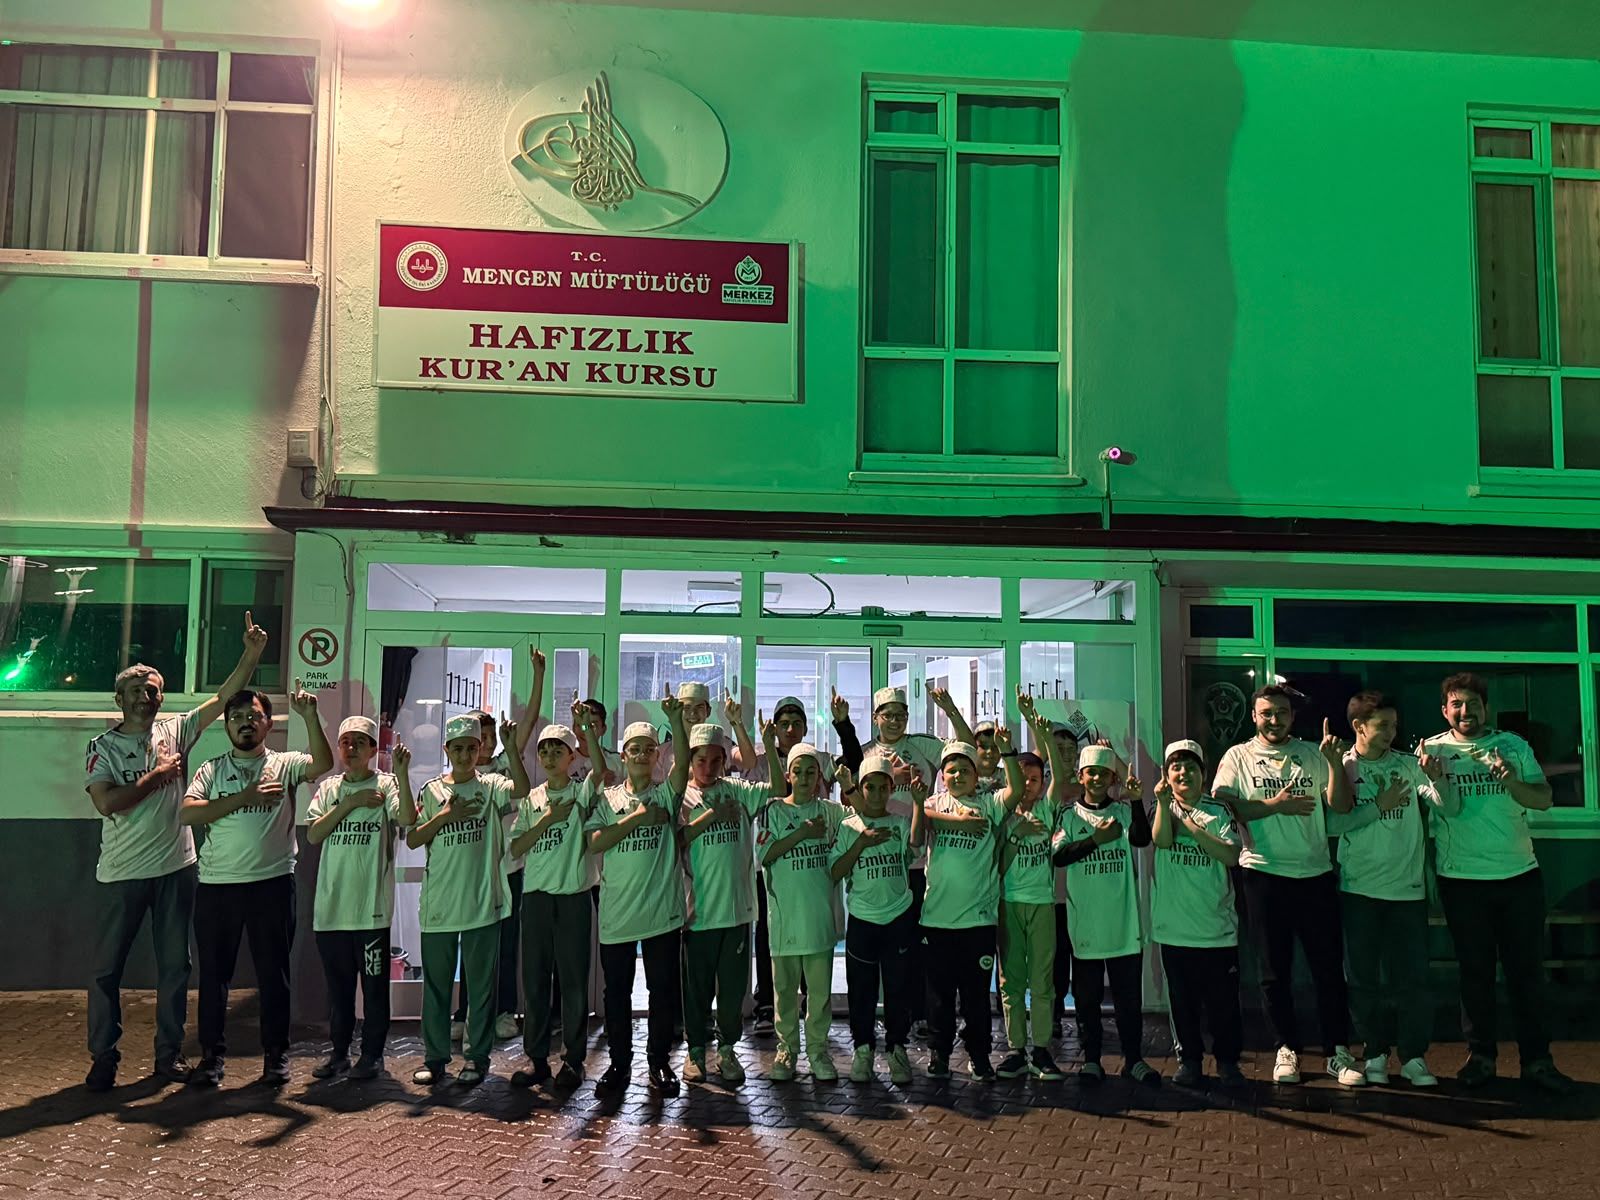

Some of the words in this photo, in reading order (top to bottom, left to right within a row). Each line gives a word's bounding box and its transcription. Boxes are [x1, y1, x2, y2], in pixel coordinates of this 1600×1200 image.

[570, 250, 607, 263] T.C.
[462, 267, 562, 287] MENGEN
[569, 270, 711, 294] MÜFTÜLÜĞÜ
[723, 289, 773, 300] MERKEZ
[469, 324, 694, 355] HAFIZLIK
[419, 357, 571, 382] KUR'AN
[586, 363, 717, 388] KURSU
[306, 671, 329, 680] PARK
[332, 818, 381, 833] mirates
[342, 834, 371, 846] BETTER
[443, 834, 455, 847] FLY
[617, 841, 631, 853] FLY
[632, 837, 659, 851] BETTER
[703, 834, 715, 846] FLY
[949, 837, 977, 850] BETTER
[792, 859, 804, 871] FLY
[1184, 855, 1211, 867] BETTER
[867, 867, 879, 881] FLY
[1085, 863, 1097, 876] FLY
